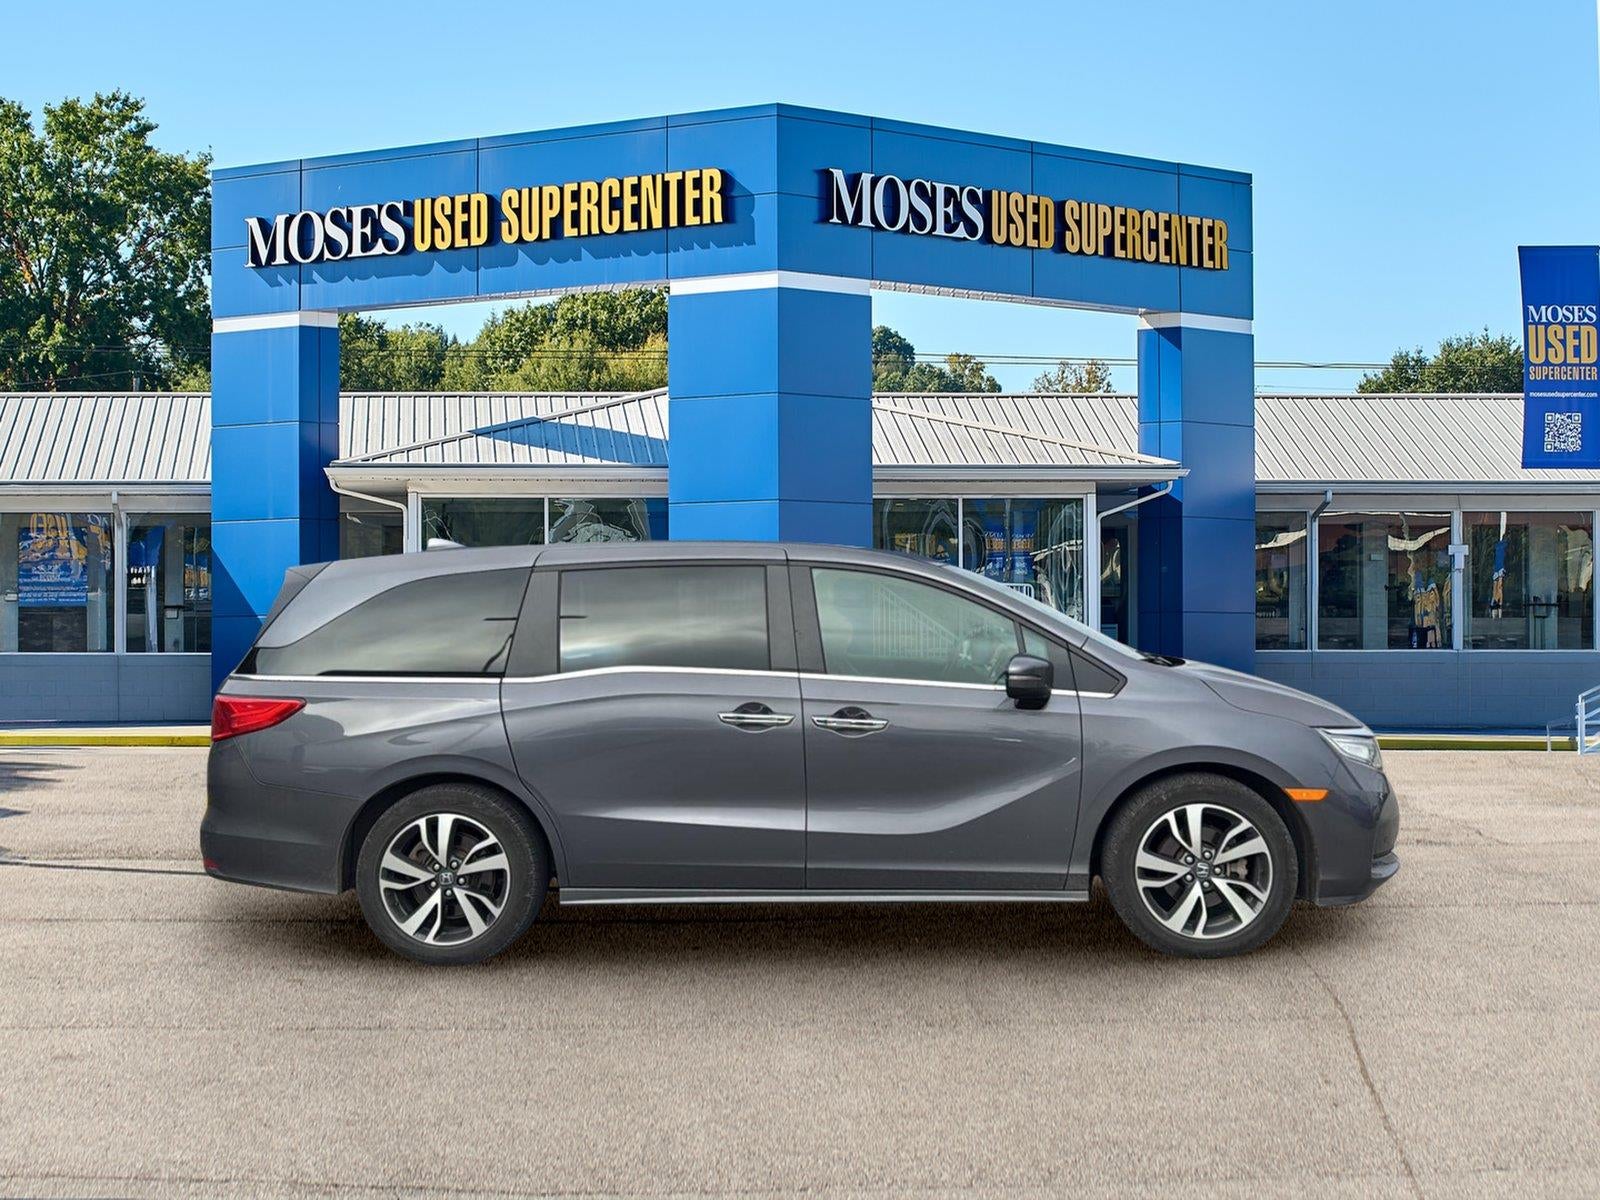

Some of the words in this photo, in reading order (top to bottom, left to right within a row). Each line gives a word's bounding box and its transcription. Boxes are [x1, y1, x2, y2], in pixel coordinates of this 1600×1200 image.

[244, 200, 406, 268] MOSES
[412, 192, 489, 252] USED
[500, 167, 724, 244] SUPERCENTER
[828, 167, 984, 241] MOSES
[990, 189, 1055, 249] USED
[1064, 199, 1230, 271] SUPERCENTER
[1527, 305, 1597, 323] MOSES
[1528, 324, 1597, 364] USED
[1529, 366, 1598, 380] SUPERCENTER
